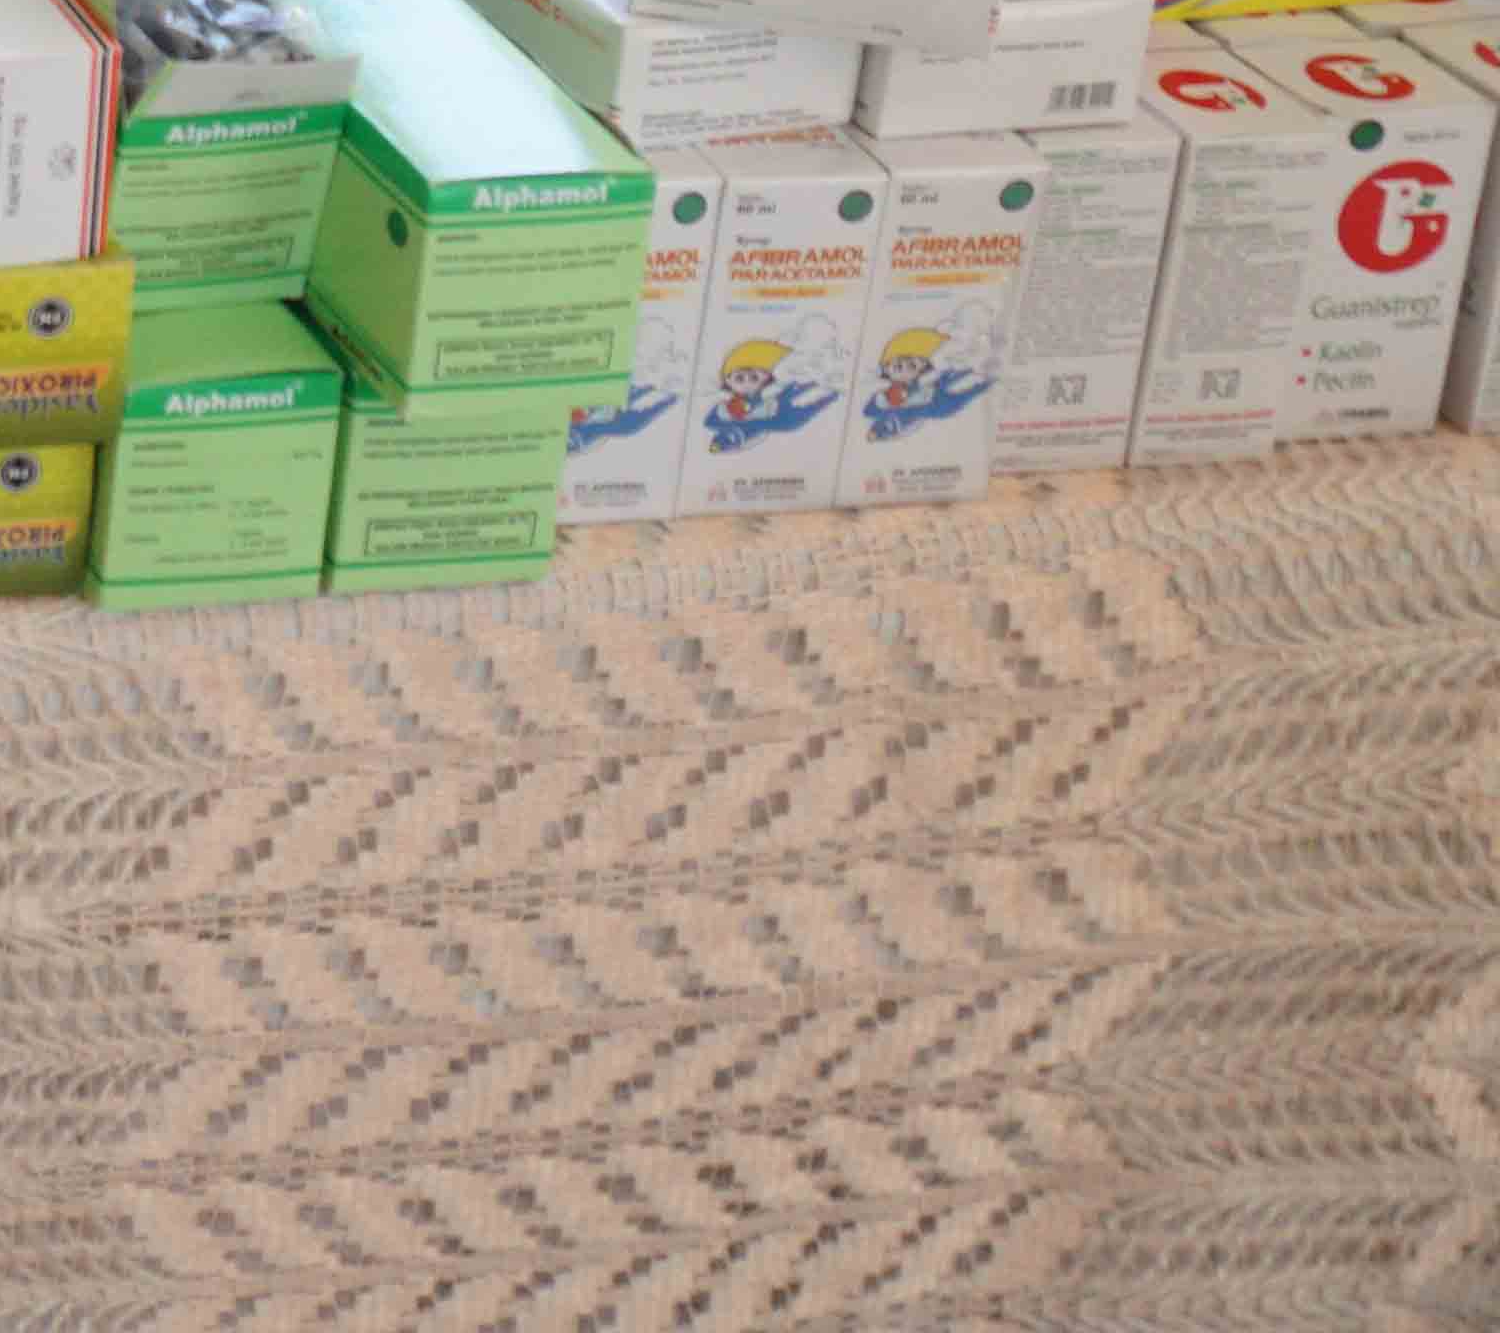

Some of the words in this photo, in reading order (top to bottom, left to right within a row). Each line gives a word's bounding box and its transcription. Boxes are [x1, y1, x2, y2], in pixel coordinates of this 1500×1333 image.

[165, 115, 298, 145] Alphamol
[473, 182, 612, 212] Alphamol
[730, 244, 866, 266] AFIBRAMOL
[892, 233, 1023, 255] AFIBRAMOL
[730, 266, 862, 282] PARACETAMOL
[891, 255, 1020, 270] PARACETAMOL
[1310, 293, 1440, 322] Guanistrep
[1317, 340, 1381, 364] Kaolin
[1312, 368, 1375, 393] Pectin
[164, 385, 296, 416] Alphamol
